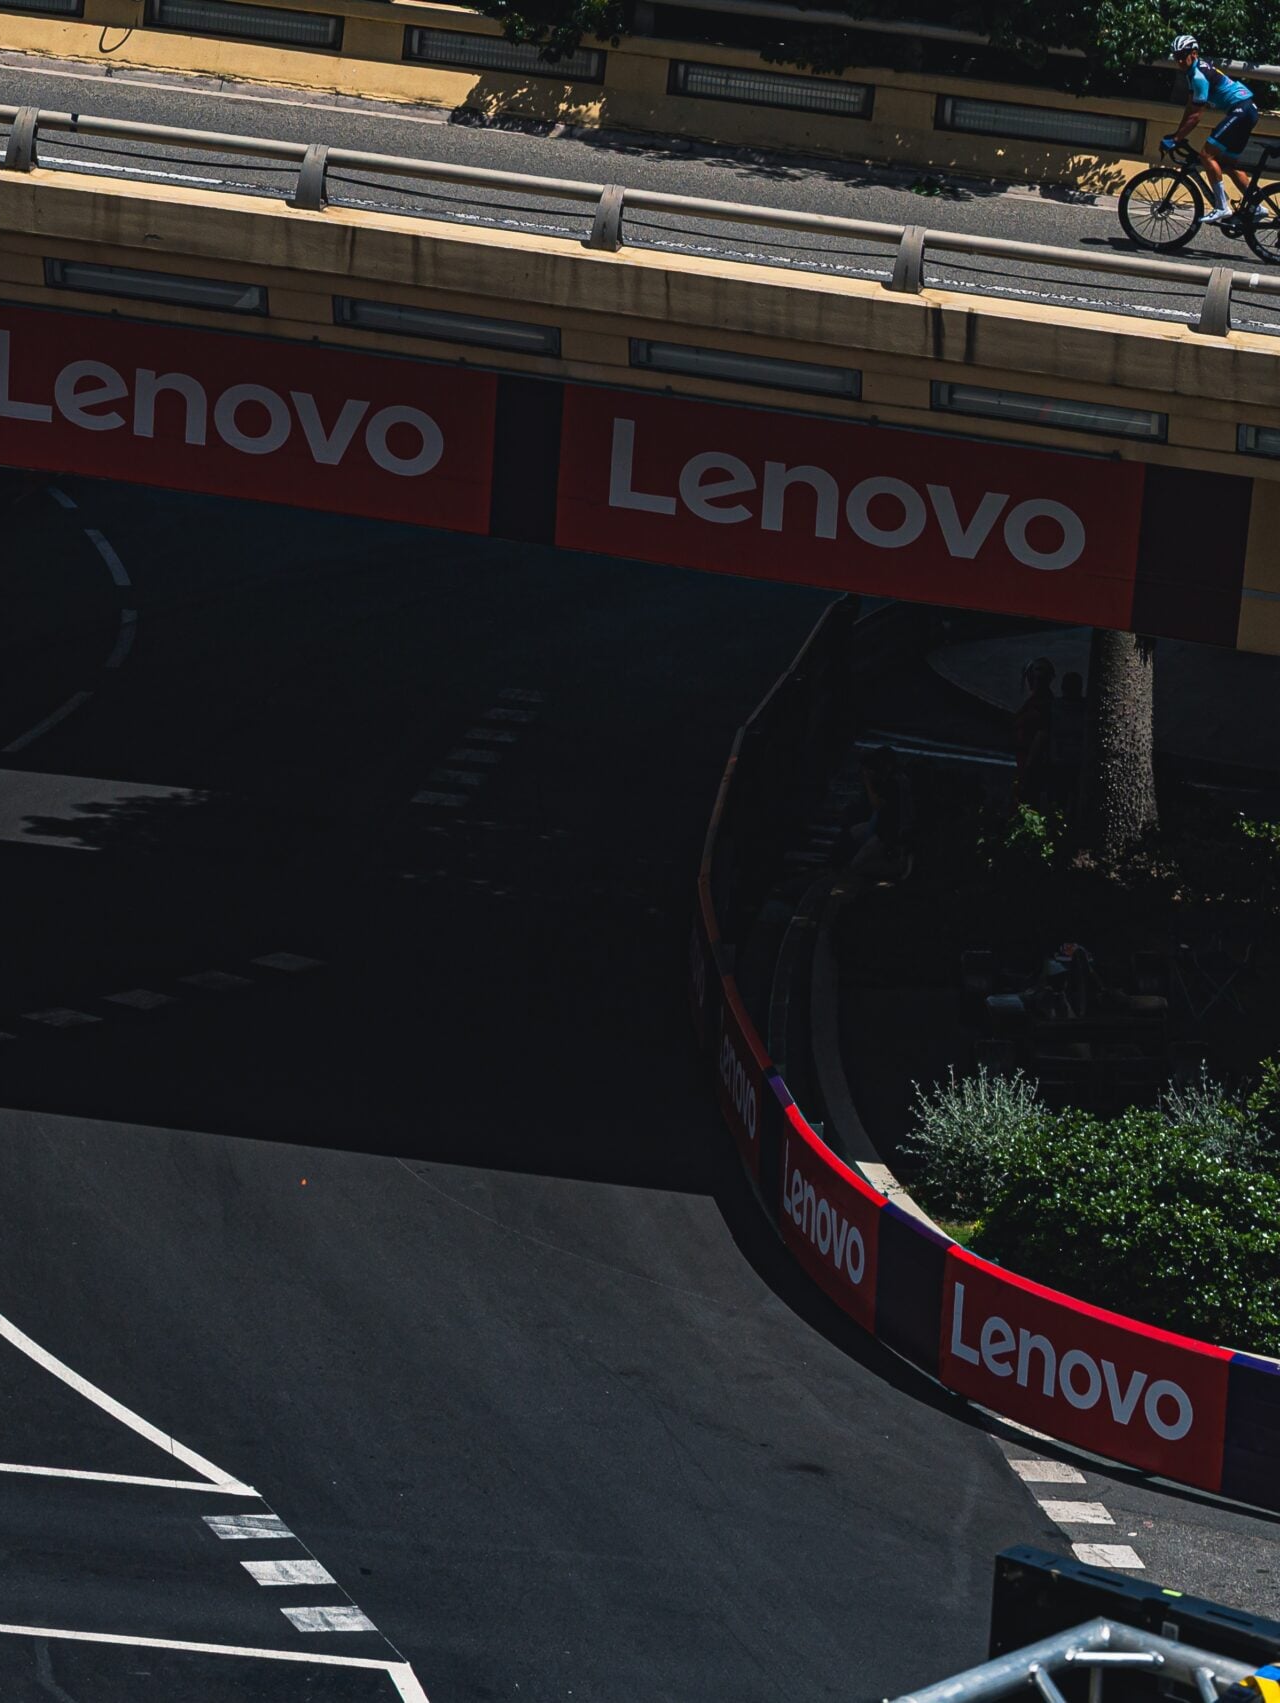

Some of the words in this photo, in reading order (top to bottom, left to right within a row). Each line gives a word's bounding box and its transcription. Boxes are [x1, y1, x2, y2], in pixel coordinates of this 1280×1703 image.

[608, 417, 1086, 571] Lenovo
[783, 1136, 866, 1286] Lenovo
[950, 1281, 1194, 1442] Lenovo
